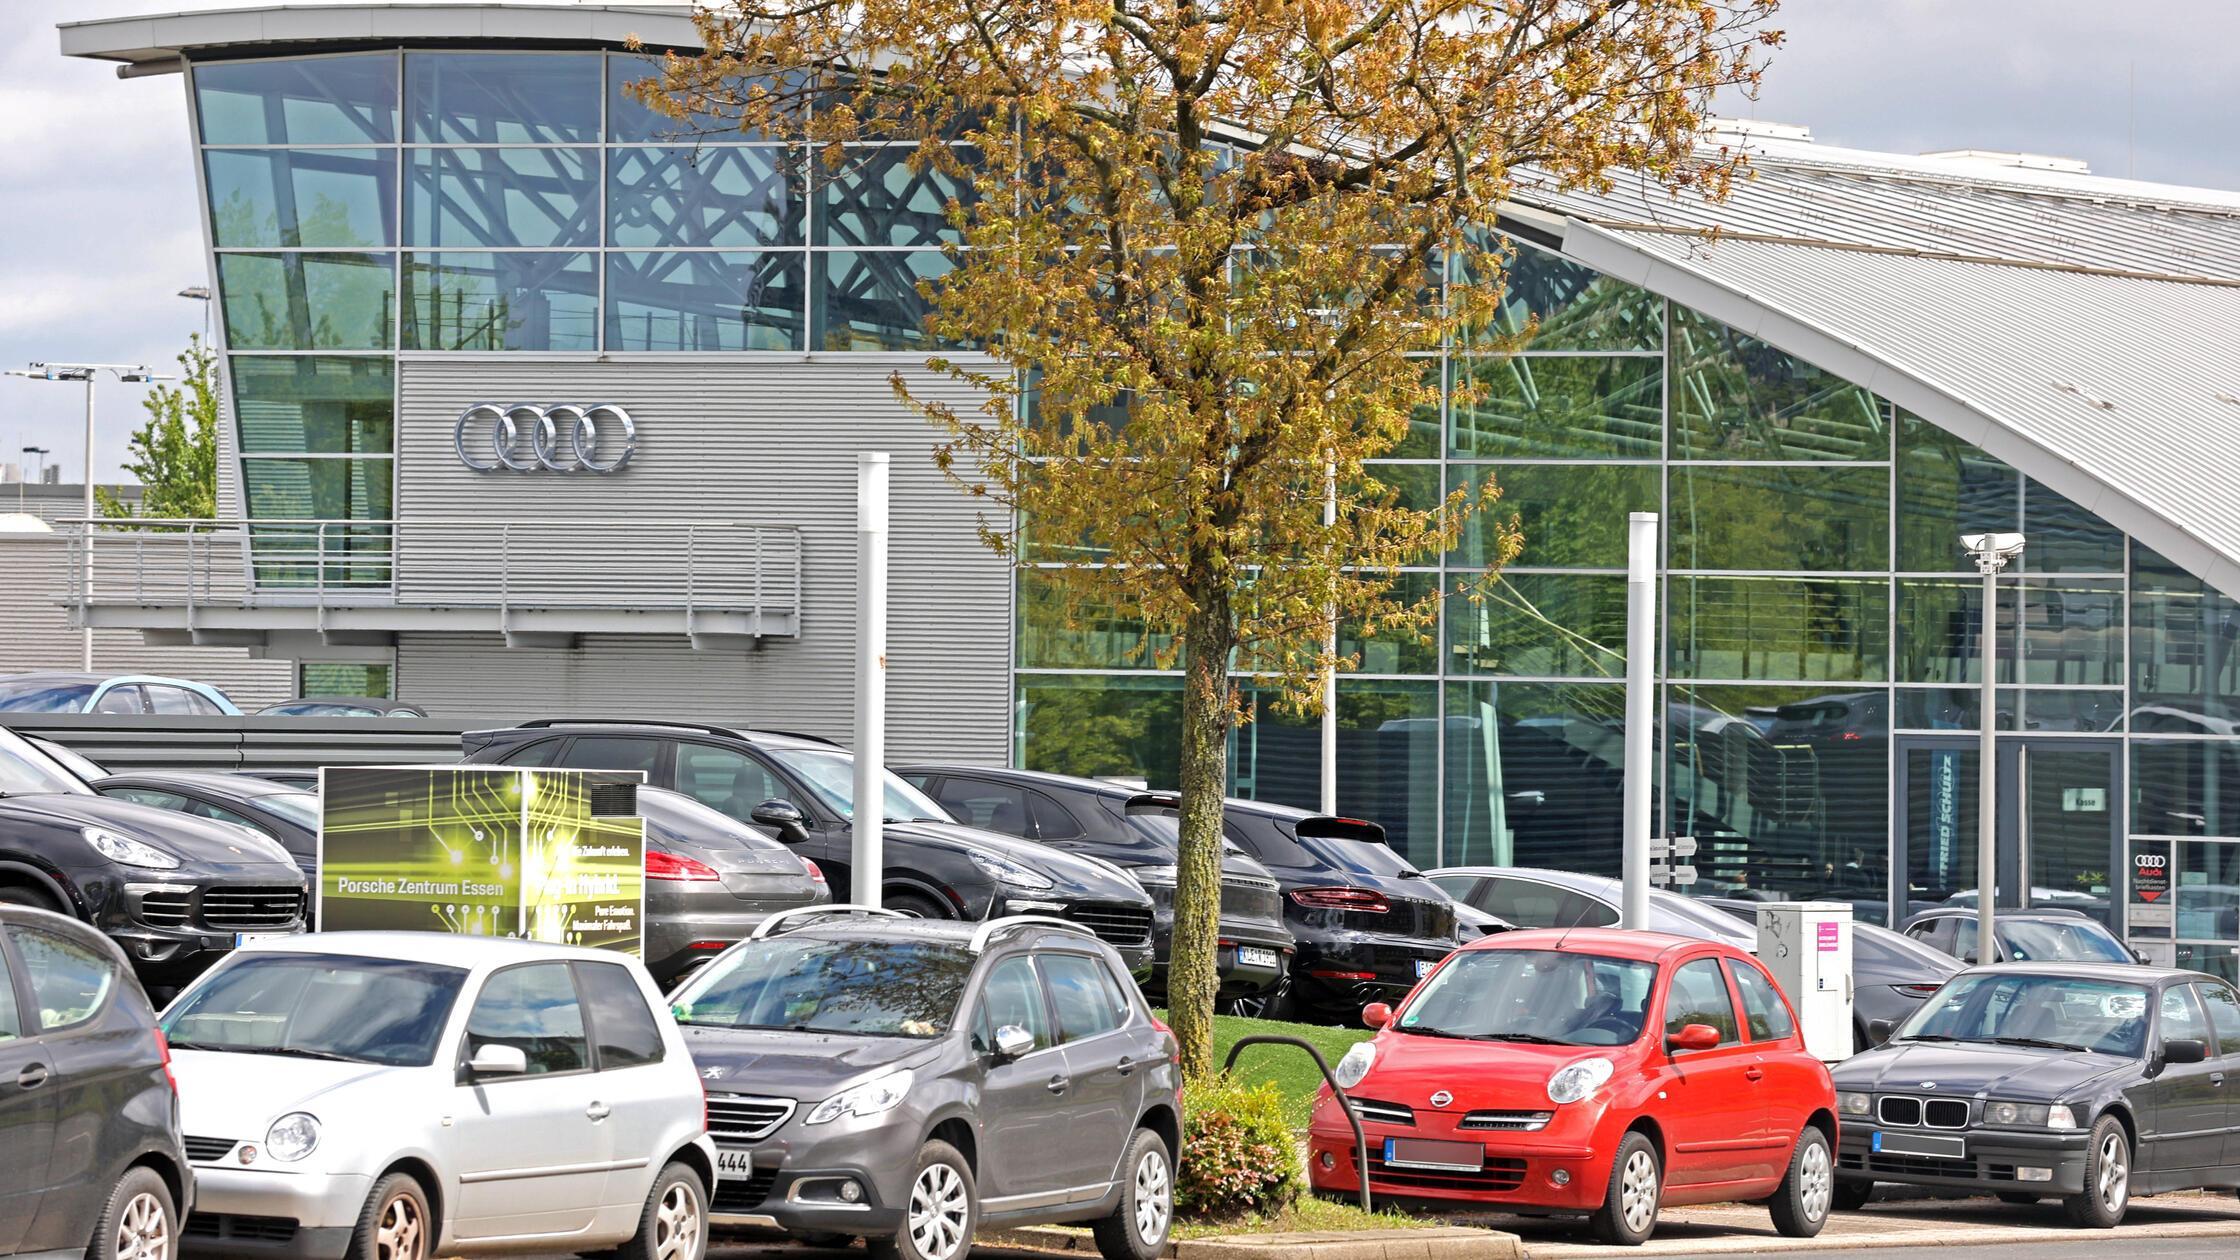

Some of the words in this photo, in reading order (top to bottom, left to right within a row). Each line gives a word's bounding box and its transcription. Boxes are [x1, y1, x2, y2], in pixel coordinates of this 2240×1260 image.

[1941, 754, 1952, 824] SCHULTZ
[2138, 867, 2162, 876] Audi
[338, 876, 396, 894] Porsche
[398, 880, 459, 895] Zentrum
[462, 880, 504, 896] Essen
[718, 1152, 747, 1173] 444
